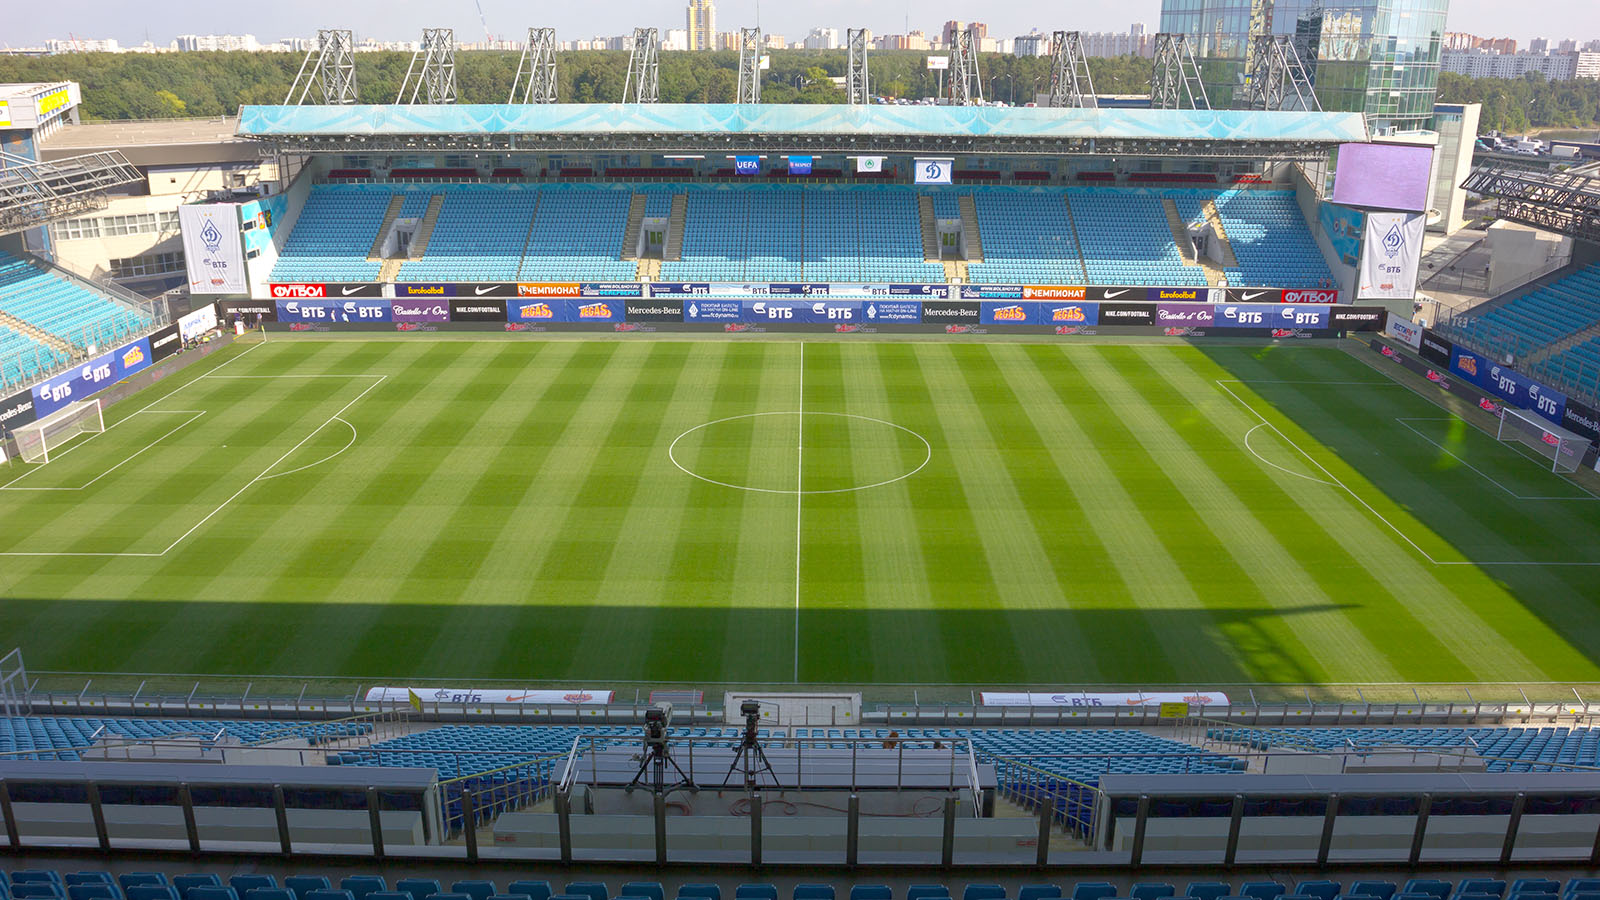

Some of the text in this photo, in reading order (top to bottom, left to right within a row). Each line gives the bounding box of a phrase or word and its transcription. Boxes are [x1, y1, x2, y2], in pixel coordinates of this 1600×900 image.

[736, 161, 757, 169] UEFA
[274, 286, 323, 297] ФУТБОЛ
[525, 286, 580, 295] ЧЕМПИОНАТ
[752, 287, 768, 295] ВТБ
[812, 287, 828, 295] ВТБ
[871, 288, 888, 296] ВТБ
[932, 288, 947, 297] ВТБ
[1031, 289, 1086, 298] ЧЕМПИОНАТ
[1284, 291, 1334, 303] ФУТБОЛ
[302, 307, 326, 318] ВТБ
[359, 307, 383, 318] ВТБ
[521, 304, 553, 318] VEGAS
[580, 304, 612, 318] VEGAS
[628, 306, 681, 315] Mercedes-Benz
[768, 307, 793, 319] ВТБ
[828, 307, 852, 319] ВТБ
[924, 308, 978, 317] Mercedes-Benz
[994, 306, 1026, 320] VEGAS
[1053, 307, 1085, 321] VEGAS
[1238, 312, 1262, 323] ВТБ
[1295, 313, 1319, 324] ВТБ
[93, 364, 111, 382] ВТБ
[1499, 376, 1516, 395] ВТБ
[52, 382, 72, 402] ВТБ
[1537, 395, 1557, 415] ВТБ
[452, 694, 482, 703] ВТБ
